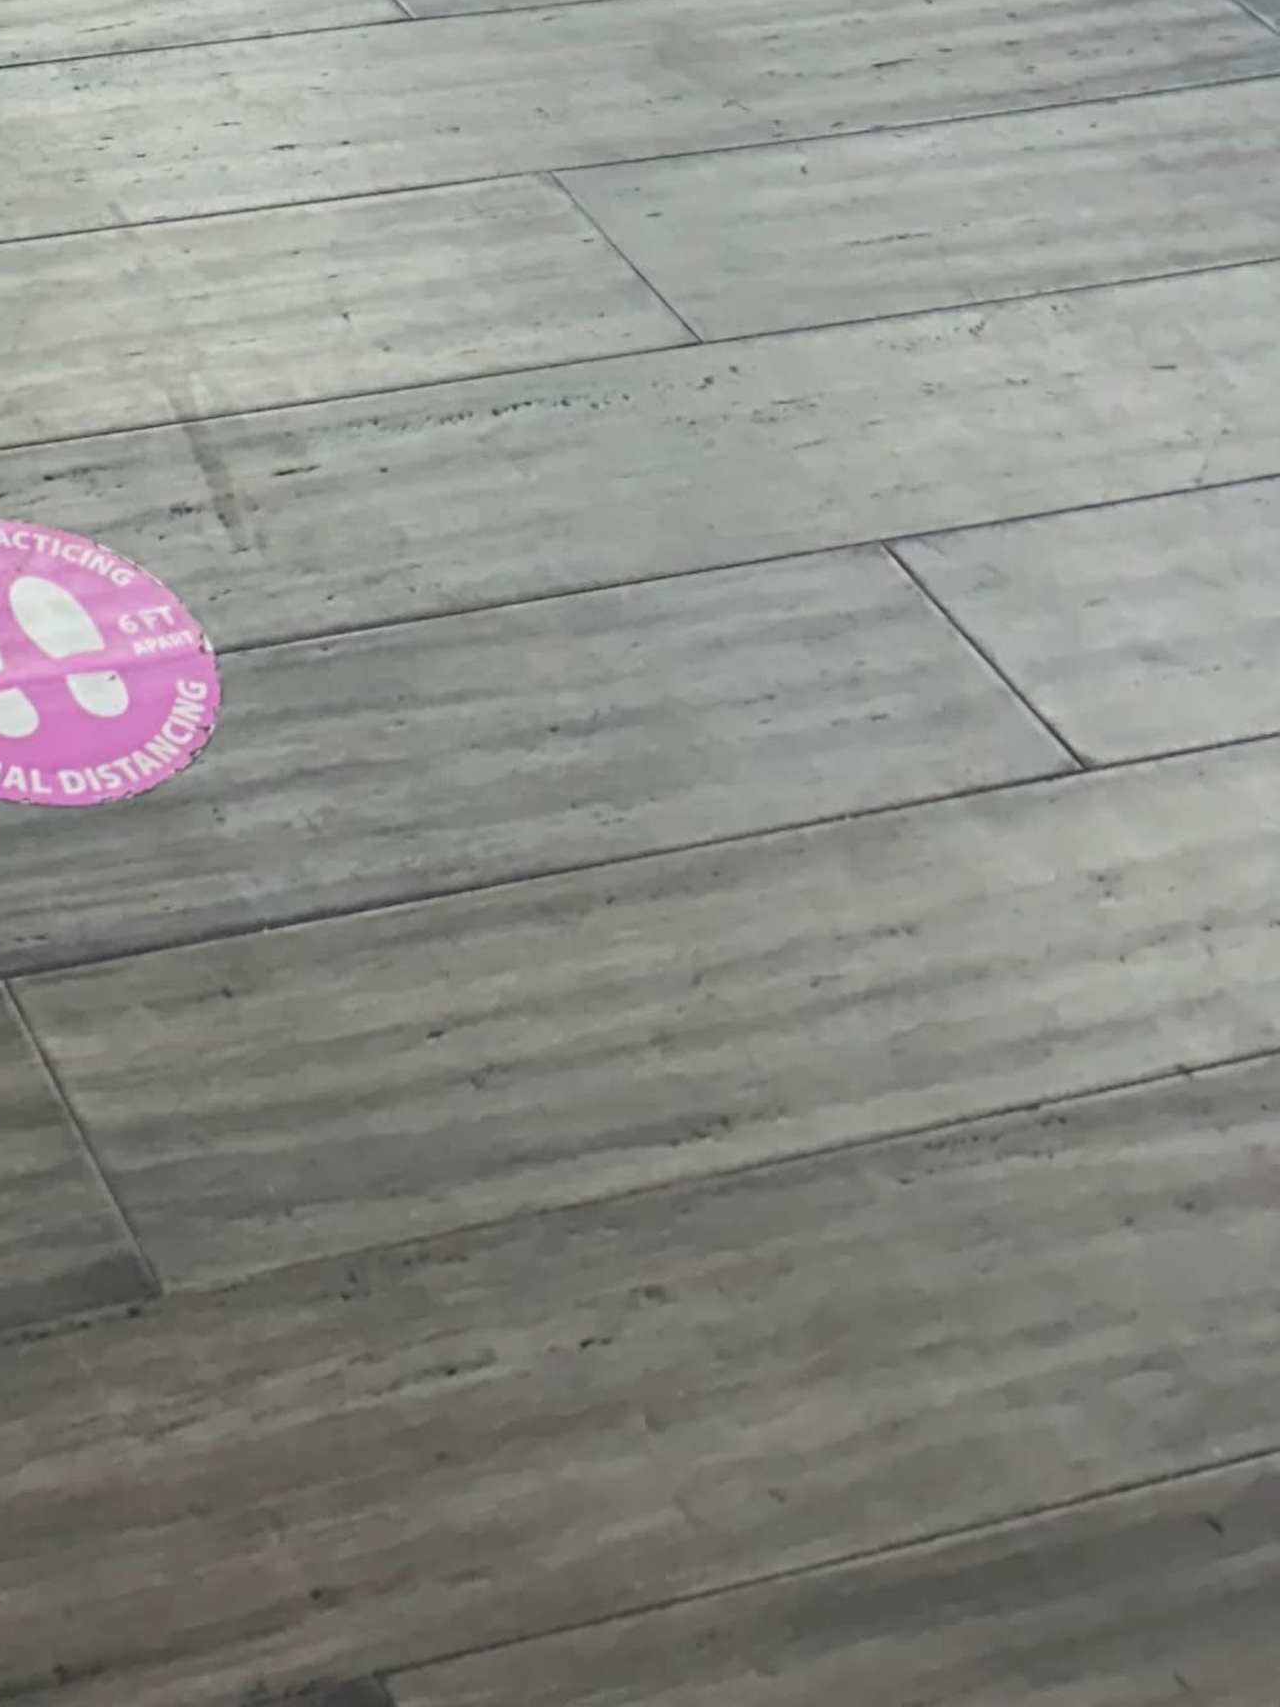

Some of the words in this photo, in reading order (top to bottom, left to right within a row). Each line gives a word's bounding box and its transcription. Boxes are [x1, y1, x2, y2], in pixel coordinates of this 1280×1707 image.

[117, 613, 140, 636] 6
[138, 605, 176, 631] FT
[132, 630, 197, 657] APART
[56, 679, 209, 795] DISTANCING
